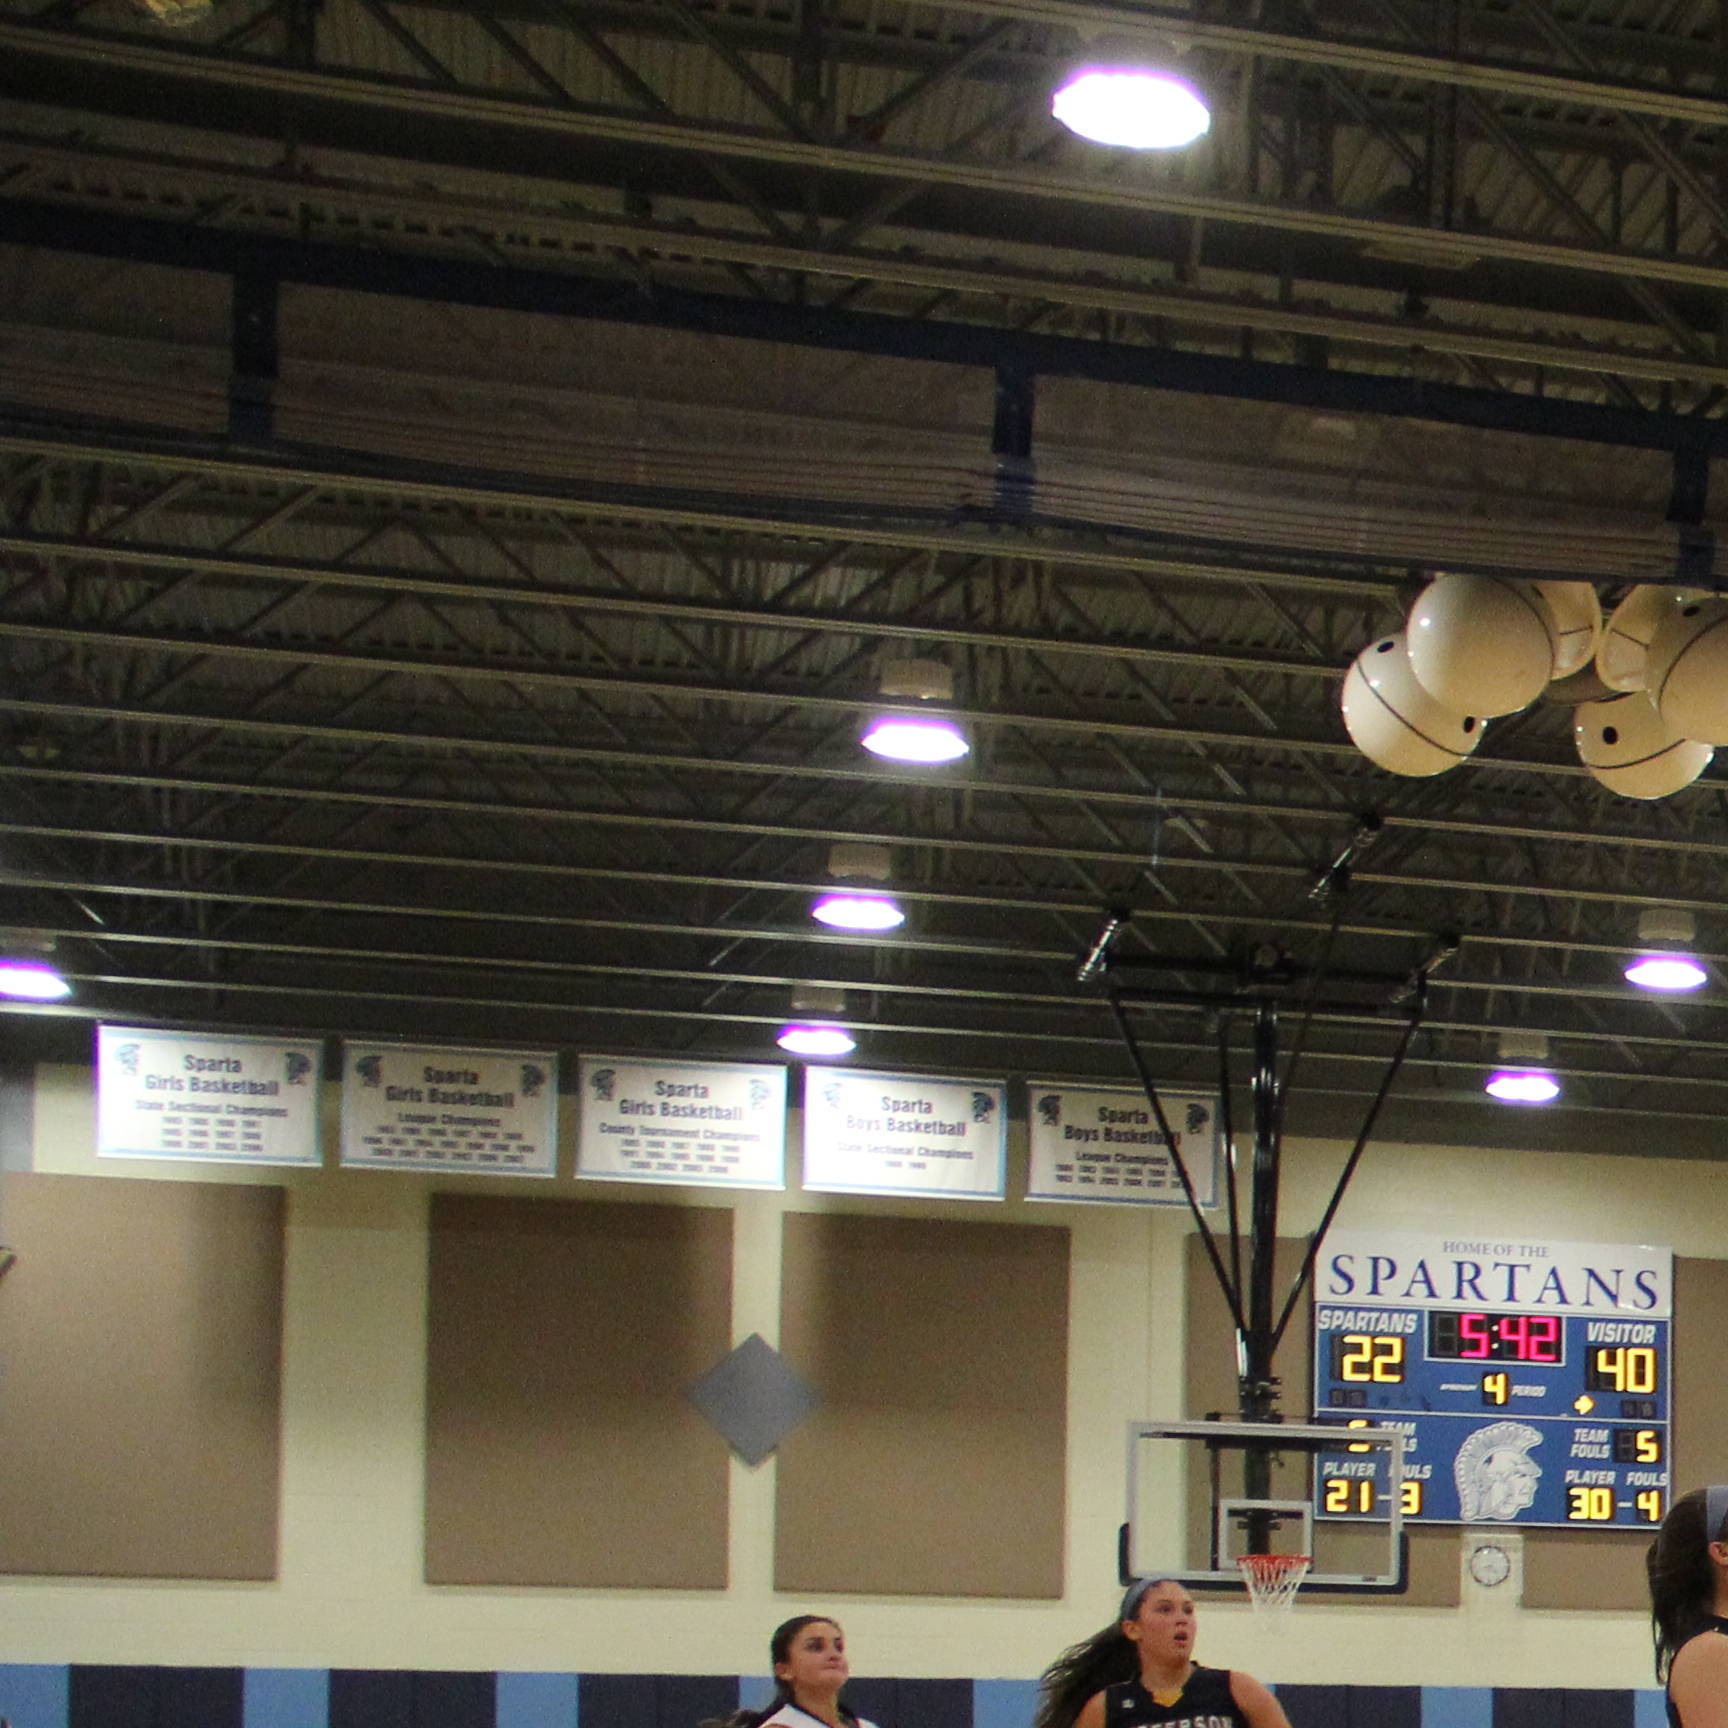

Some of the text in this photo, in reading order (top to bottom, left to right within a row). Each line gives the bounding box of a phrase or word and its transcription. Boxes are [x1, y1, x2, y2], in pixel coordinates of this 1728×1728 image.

[184, 1054, 243, 1073] Sparta
[146, 1075, 279, 1096] Girls Basketball
[424, 1066, 480, 1085] Sparta
[386, 1086, 515, 1107] Girls Basketball
[655, 1080, 710, 1099] Sparta
[620, 1100, 743, 1121] Girls Basketball
[881, 1096, 933, 1114] Sparta
[1098, 1106, 1149, 1124] Sparta
[847, 1115, 966, 1136] Boys Basketball
[1064, 1125, 1182, 1146] Boys Basketbll
[1443, 1241, 1550, 1258] HOME OF THE
[1329, 1254, 1658, 1310] SPARTANS
[1318, 1309, 1418, 1334] SPARTANS
[1460, 1313, 1559, 1361] 5:42
[1587, 1321, 1657, 1344] VISITOR
[1342, 1335, 1403, 1383] 22
[1597, 1347, 1656, 1393] 40
[1483, 1373, 1507, 1405] 4
[1511, 1385, 1547, 1397] PERIOD
[1573, 1428, 1609, 1442] TEAM
[1570, 1444, 1611, 1459] FOULS
[1636, 1430, 1659, 1462] 5
[1322, 1462, 1376, 1476] PLAYER
[1564, 1470, 1668, 1486] PLAYER FOULS
[1325, 1479, 1372, 1513] 21
[1568, 1487, 1659, 1521] 30 4
